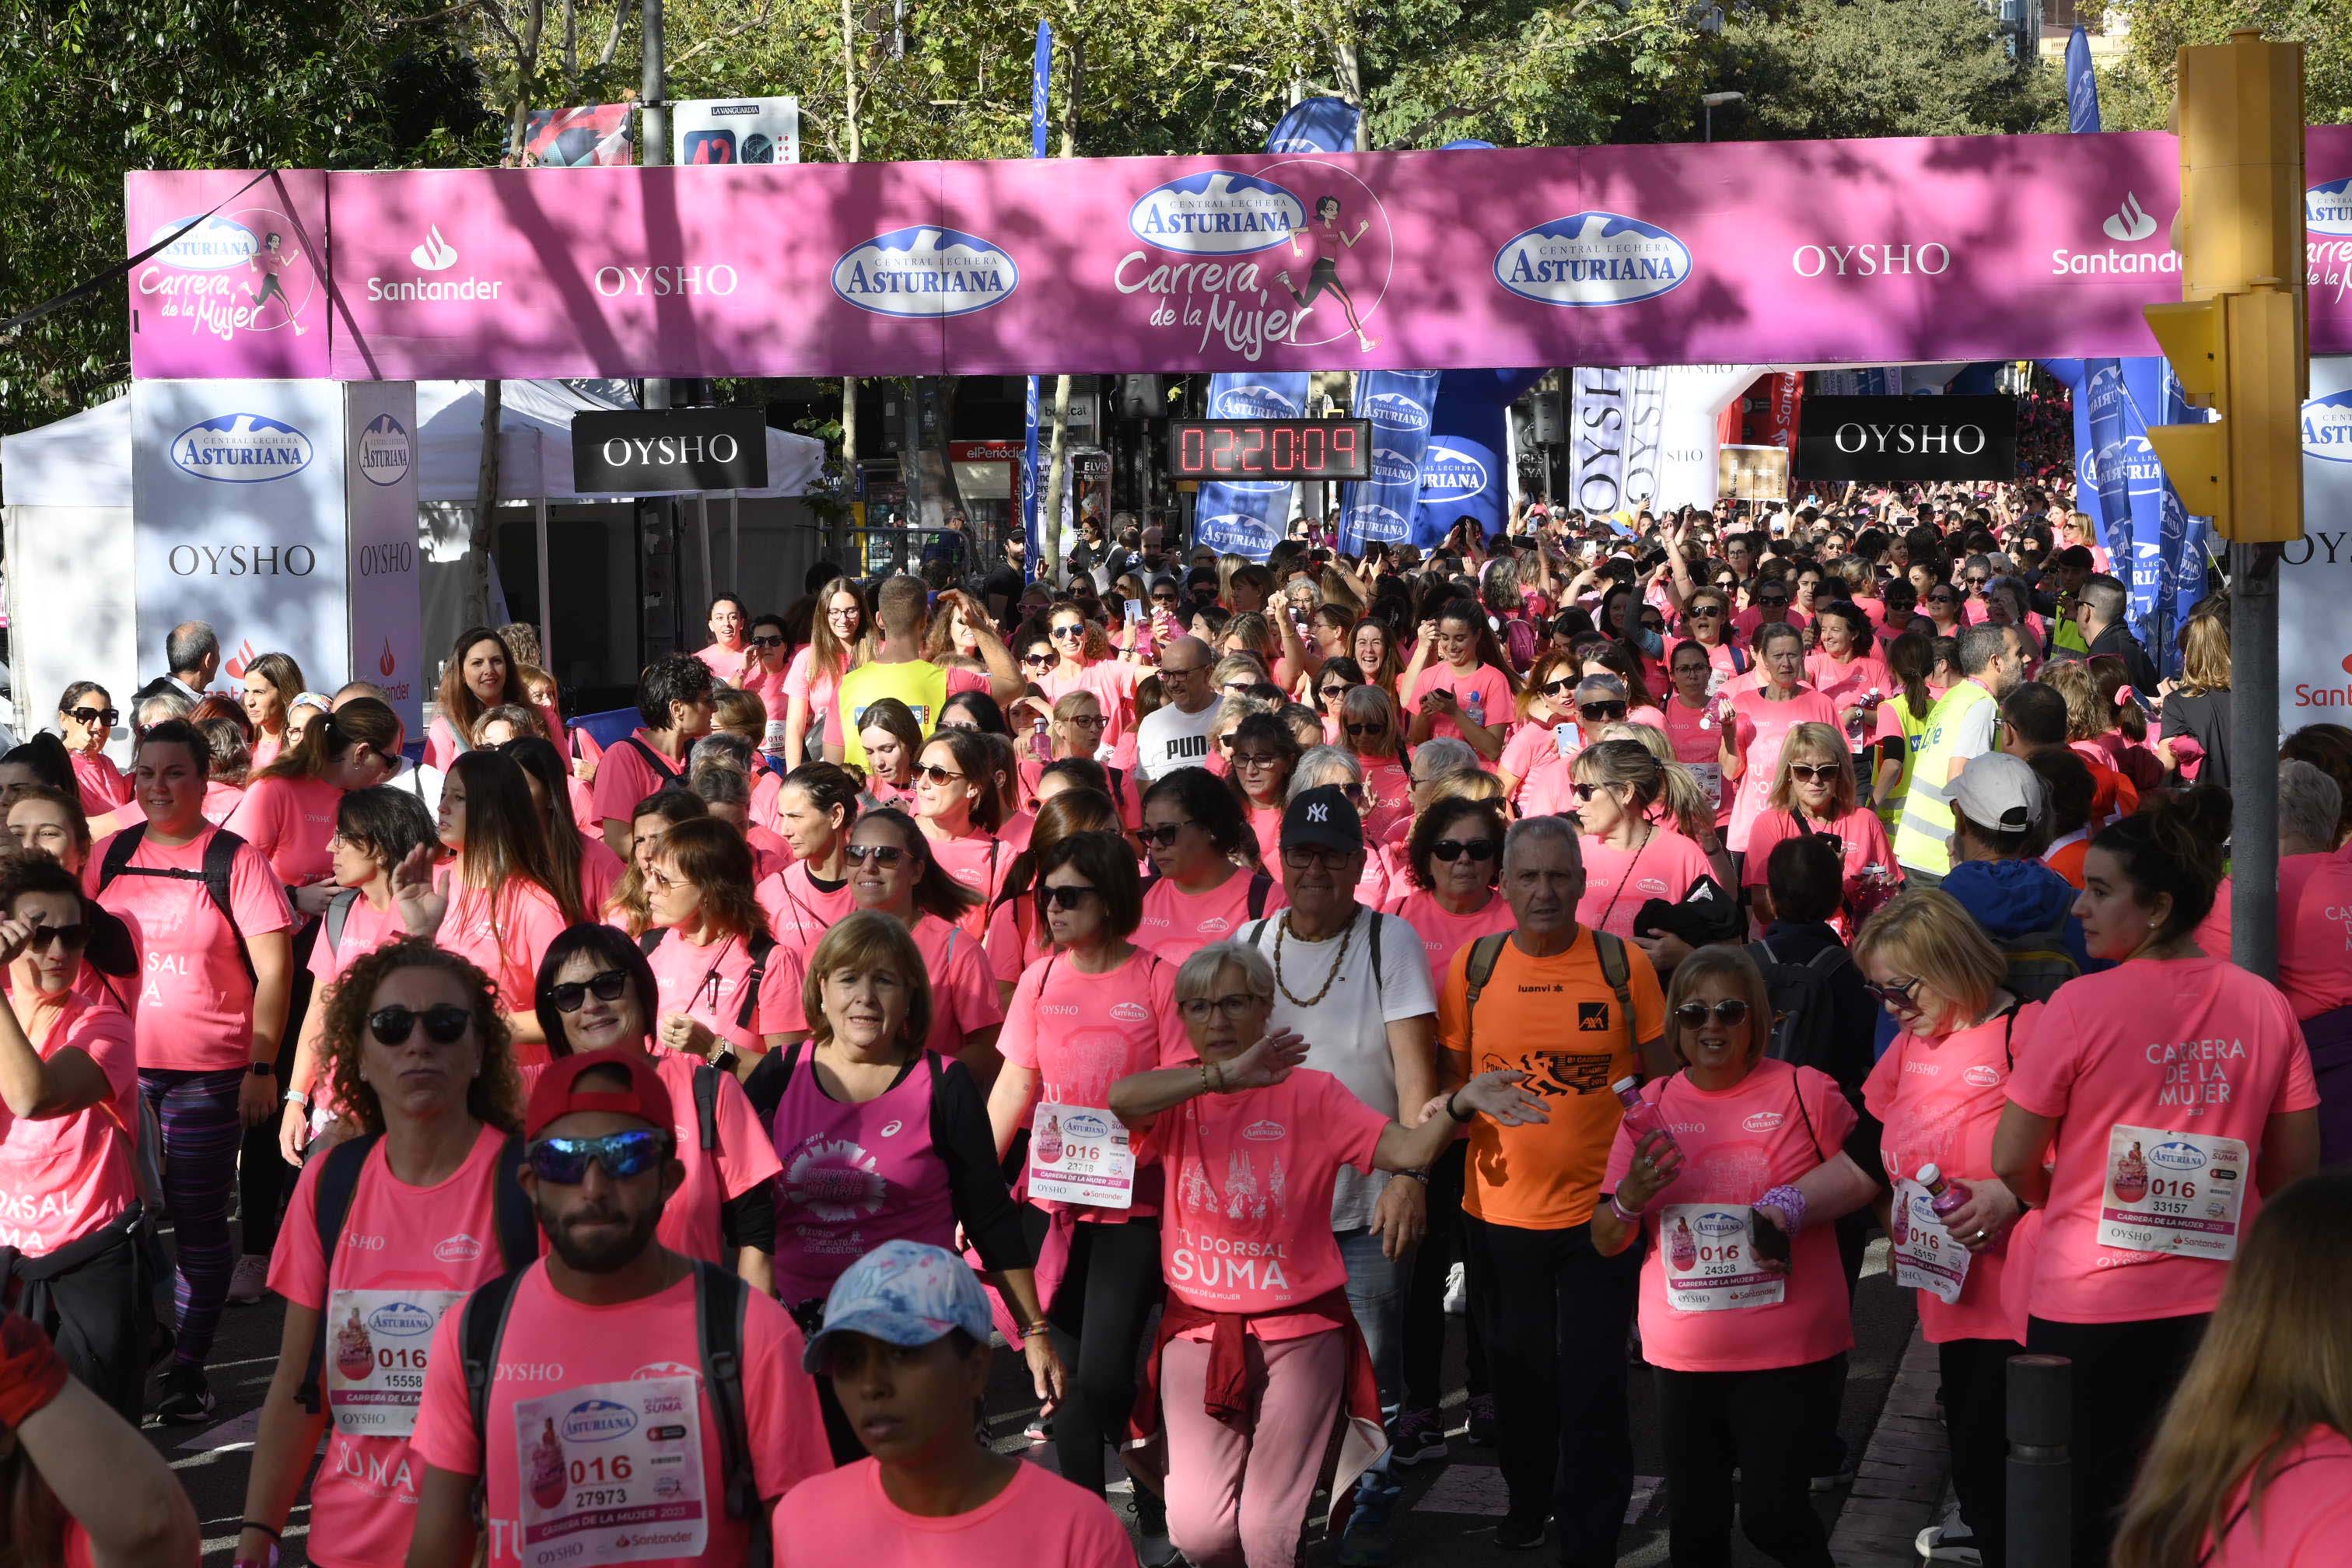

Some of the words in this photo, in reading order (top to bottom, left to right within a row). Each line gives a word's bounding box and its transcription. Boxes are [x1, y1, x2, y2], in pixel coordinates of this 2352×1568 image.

[721, 106, 758, 114] VANGUARDIA
[1231, 198, 1287, 207] LECHERA
[2306, 200, 2352, 222] ASTU
[1143, 201, 1291, 235] ASTURIANA
[1540, 244, 1597, 255] CENTRAL
[1602, 243, 1670, 254] LECHERA
[874, 257, 933, 266] CENTRAL
[940, 257, 998, 265] LECHERA
[1509, 248, 1676, 284] ASTURIANA
[1792, 243, 1950, 277] OYSHO
[138, 266, 230, 296] Carrera
[594, 264, 738, 297] OYSHO
[846, 260, 1004, 294] ASTURIANA
[1114, 250, 1260, 296] Carrera
[2325, 264, 2339, 285] la
[368, 276, 502, 302] Santander
[161, 296, 178, 317] de
[182, 295, 194, 317] la
[191, 293, 266, 341] Mujer
[1150, 296, 1178, 327] de
[1182, 295, 1203, 327] la
[1198, 288, 1314, 362] Mujer
[1363, 403, 1423, 426] ASTURIANA
[603, 433, 738, 466] OYSHO
[1182, 428, 1356, 471] 02:20:09
[1835, 422, 1986, 456] OYSHO
[182, 439, 303, 466] ASTURIANA
[362, 442, 408, 468] ASTURIANA
[1084, 462, 1108, 471] ELVIS
[1202, 525, 1273, 551] ASTURIANA
[2279, 532, 2352, 565] OY
[169, 545, 315, 576] OYSHO
[360, 542, 411, 577] OYSHO
[1307, 802, 1328, 822] NY
[146, 951, 187, 976] SAL
[1041, 1005, 1079, 1016] OYSHO
[1580, 1016, 1604, 1029] AXA
[2146, 1038, 2246, 1064] CARRERA
[2165, 1063, 2190, 1083] DE
[2199, 1062, 2226, 1082] LA
[2158, 1083, 2231, 1106] MUJER
[1066, 1122, 1104, 1135] ASTURIANA
[1066, 1143, 1100, 1162] 016
[2153, 1150, 2203, 1166] ASTURIANA
[2212, 1153, 2238, 1163] SUMA
[1040, 1171, 1067, 1181] CARRERA
[1087, 1177, 1108, 1185] MUJER
[1067, 1161, 1094, 1174] 23718
[1038, 1183, 1067, 1195] OYSHO
[1090, 1190, 1123, 1201] Santander
[2151, 1178, 2196, 1199] 016
[2153, 1201, 2188, 1214] 33157
[1697, 1220, 1741, 1231] ASTURIANA
[2117, 1213, 2153, 1224] CARRERA
[2178, 1219, 2203, 1229] MUJER
[1200, 1234, 1287, 1258] DORSAL
[1910, 1227, 1939, 1249] 016
[2111, 1227, 2152, 1242] OYSHO
[2184, 1237, 2226, 1250] Santander
[1700, 1244, 1739, 1262] 016
[1913, 1247, 1937, 1262] 25157
[1171, 1248, 1289, 1290] SUMA
[1704, 1264, 1736, 1275] 24328
[1678, 1279, 1707, 1288] CARRERA
[1216, 1292, 1241, 1300] MUJER
[1678, 1293, 1710, 1303] OYSHO
[1740, 1288, 1776, 1299] Santander
[373, 1314, 429, 1329] ASTURIANA
[378, 1348, 427, 1369] 016
[385, 1375, 423, 1388] 15558
[347, 1393, 387, 1402] CARRERA
[644, 1402, 683, 1414] SUMA
[342, 1412, 386, 1425] OYSHO
[566, 1417, 631, 1434] ASTURIANA
[338, 1440, 415, 1492] SUMA
[570, 1454, 632, 1485] 016
[576, 1489, 627, 1508] 27973
[542, 1518, 581, 1536] CARRERA
[582, 1517, 597, 1525] DE
[600, 1514, 614, 1524] LA
[617, 1510, 656, 1522] MUJER
[537, 1542, 583, 1566] OYSHO
[631, 1531, 692, 1546] Santander
